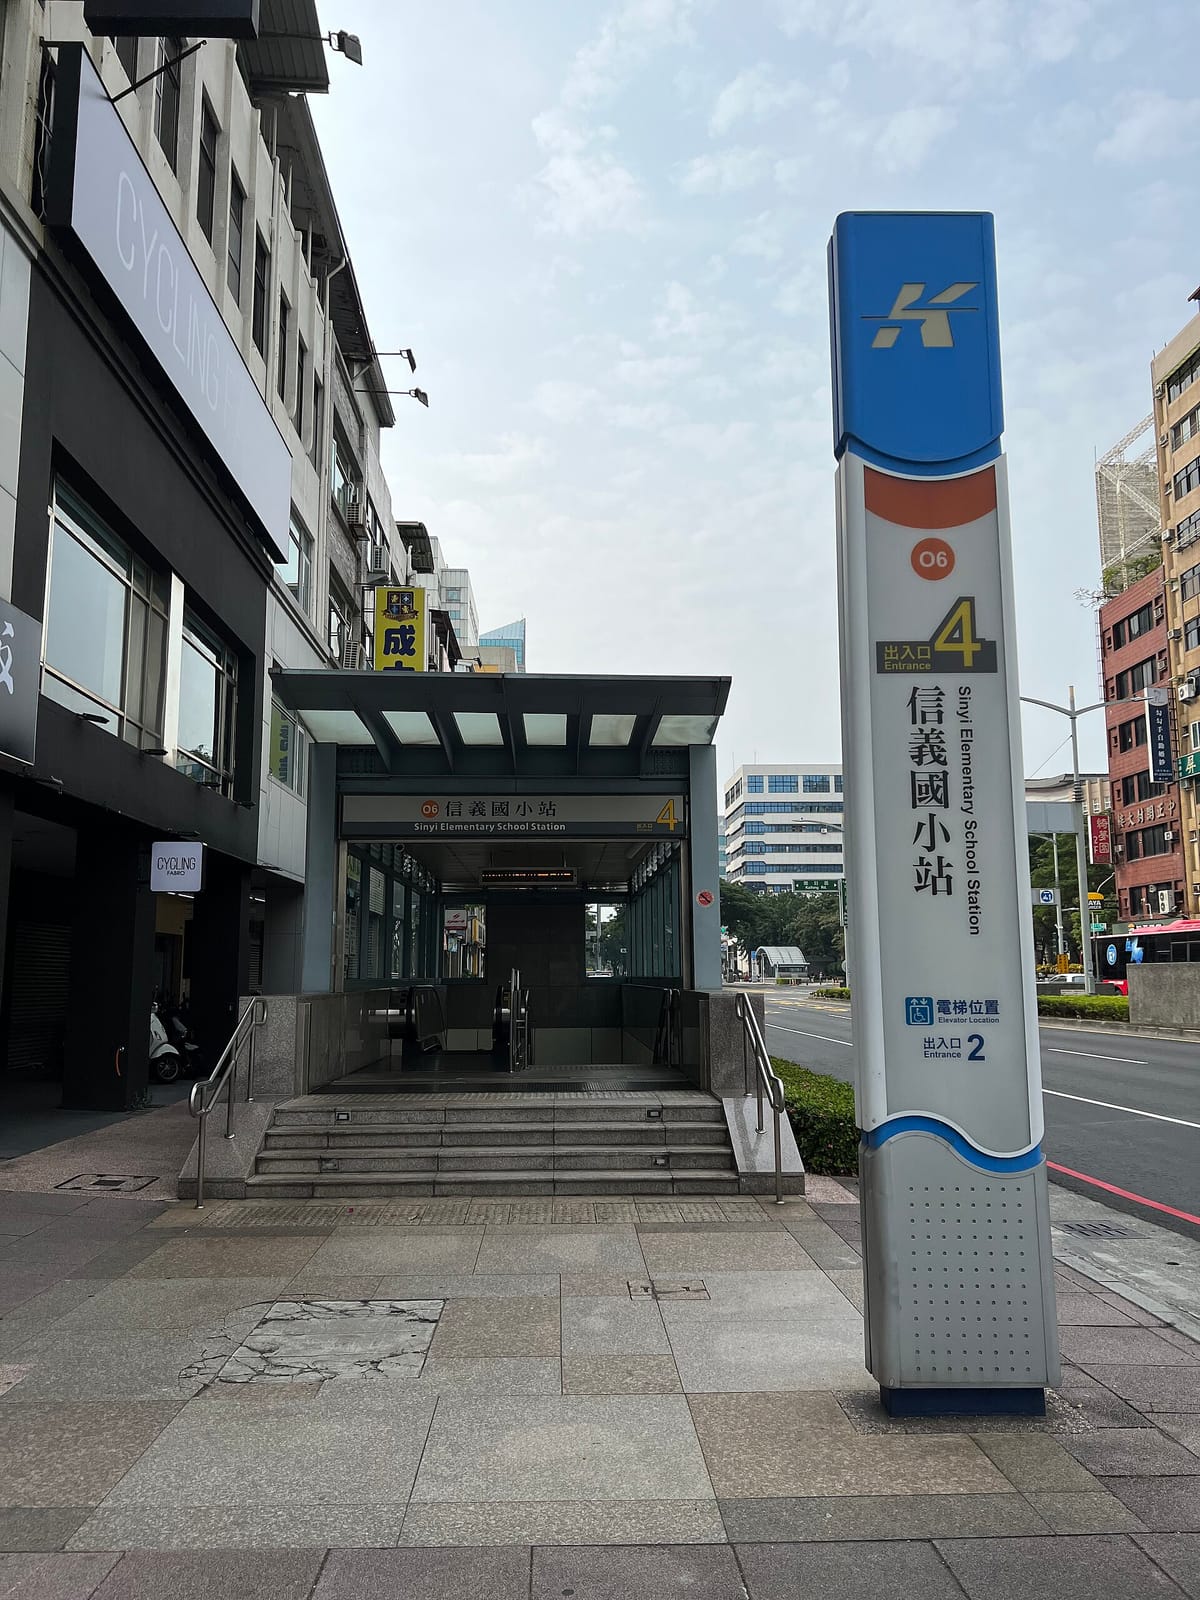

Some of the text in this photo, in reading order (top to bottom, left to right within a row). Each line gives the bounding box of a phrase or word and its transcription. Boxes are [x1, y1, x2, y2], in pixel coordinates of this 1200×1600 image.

[114, 170, 220, 411] CYCLING
[934, 600, 982, 668] 4
[382, 624, 416, 672] 成
[884, 644, 931, 660] 出入口
[884, 661, 932, 671] Entrance
[906, 685, 954, 896] 信義國小站
[445, 801, 557, 817] 信義國小站
[656, 799, 679, 832] 4
[956, 685, 981, 936] Sinyi Elementary School Station
[414, 822, 566, 832] Sinyi Elementary School Station
[157, 857, 196, 870] CYCLING
[936, 999, 1001, 1015] 電梯位置
[938, 1016, 1000, 1024] Elevator Location
[923, 1036, 961, 1050] 出入口
[967, 1033, 986, 1061] 2
[923, 1050, 962, 1059] Entrance
